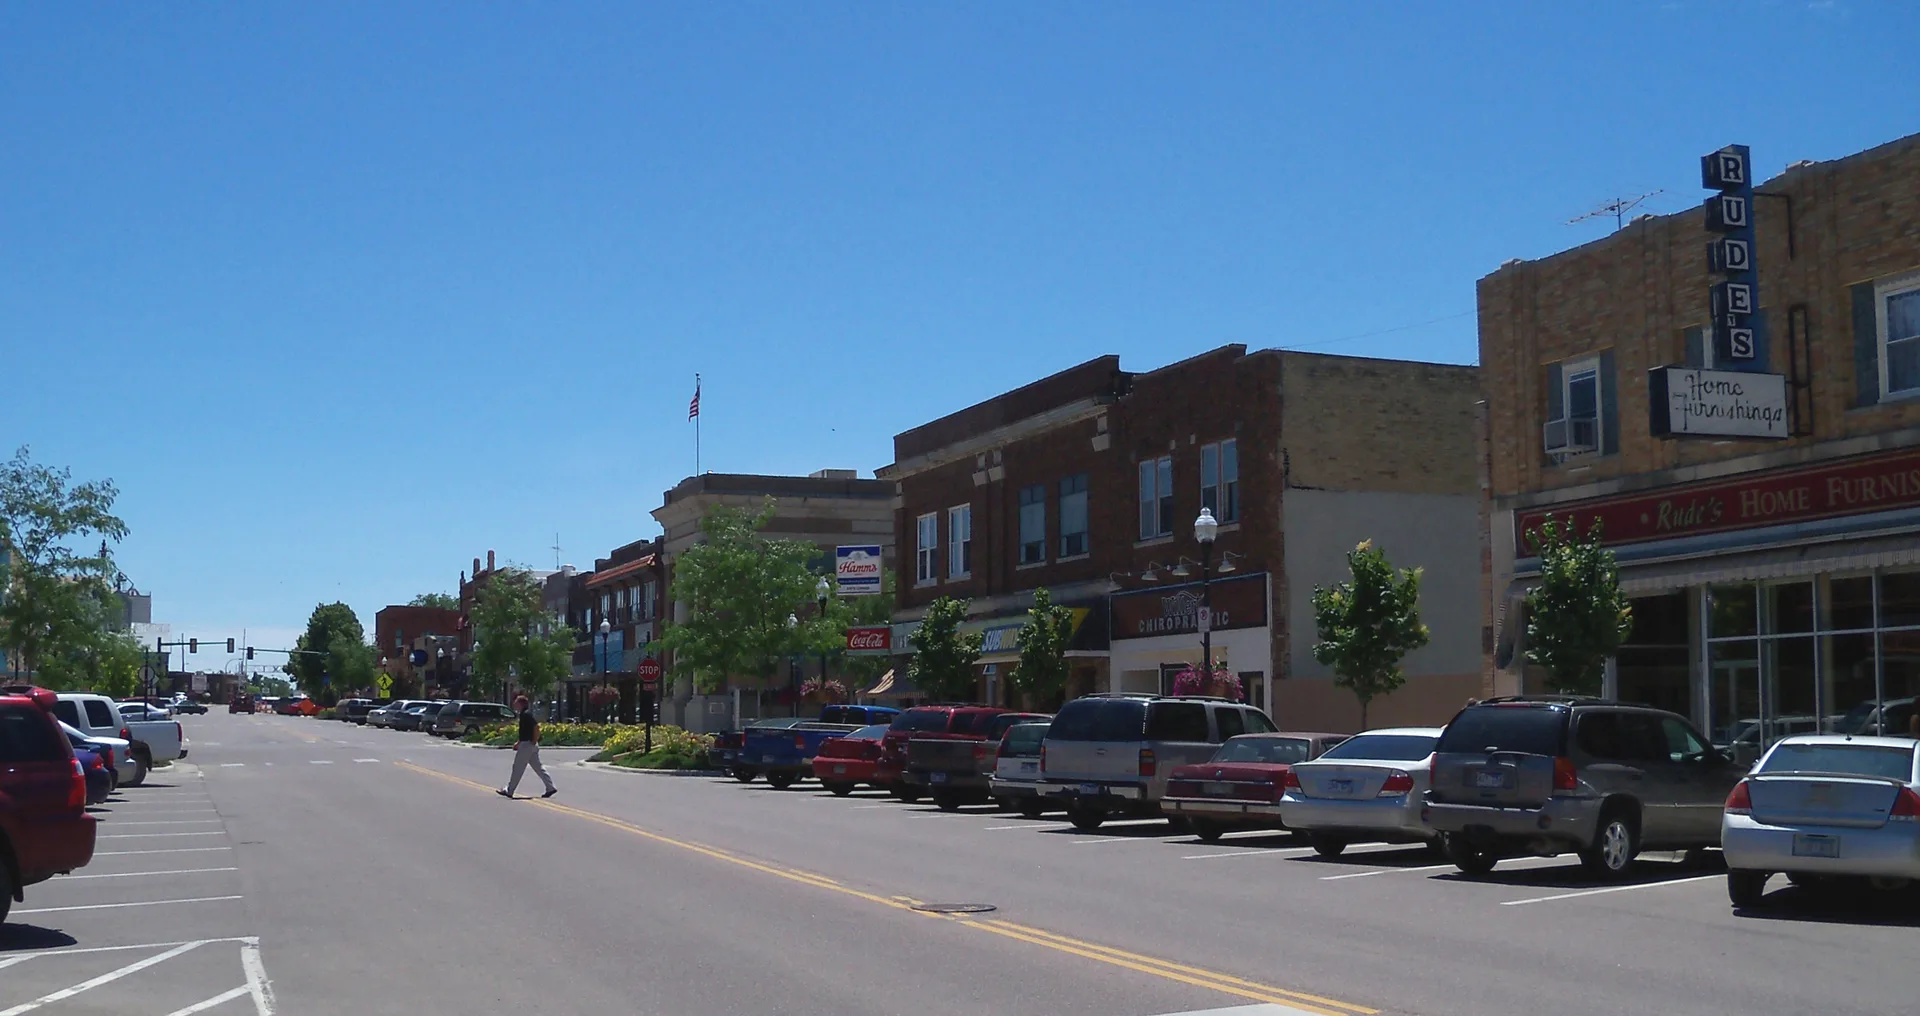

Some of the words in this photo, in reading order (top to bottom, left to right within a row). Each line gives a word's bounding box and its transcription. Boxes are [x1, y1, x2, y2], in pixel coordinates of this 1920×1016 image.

[1685, 370, 1744, 400] Home
[1672, 391, 1783, 431] Furnishings
[1656, 496, 1724, 531] Rude's
[1740, 487, 1810, 518] HOME
[1138, 611, 1229, 633] CHIROPRATIC
[640, 665, 659, 675] STOP
